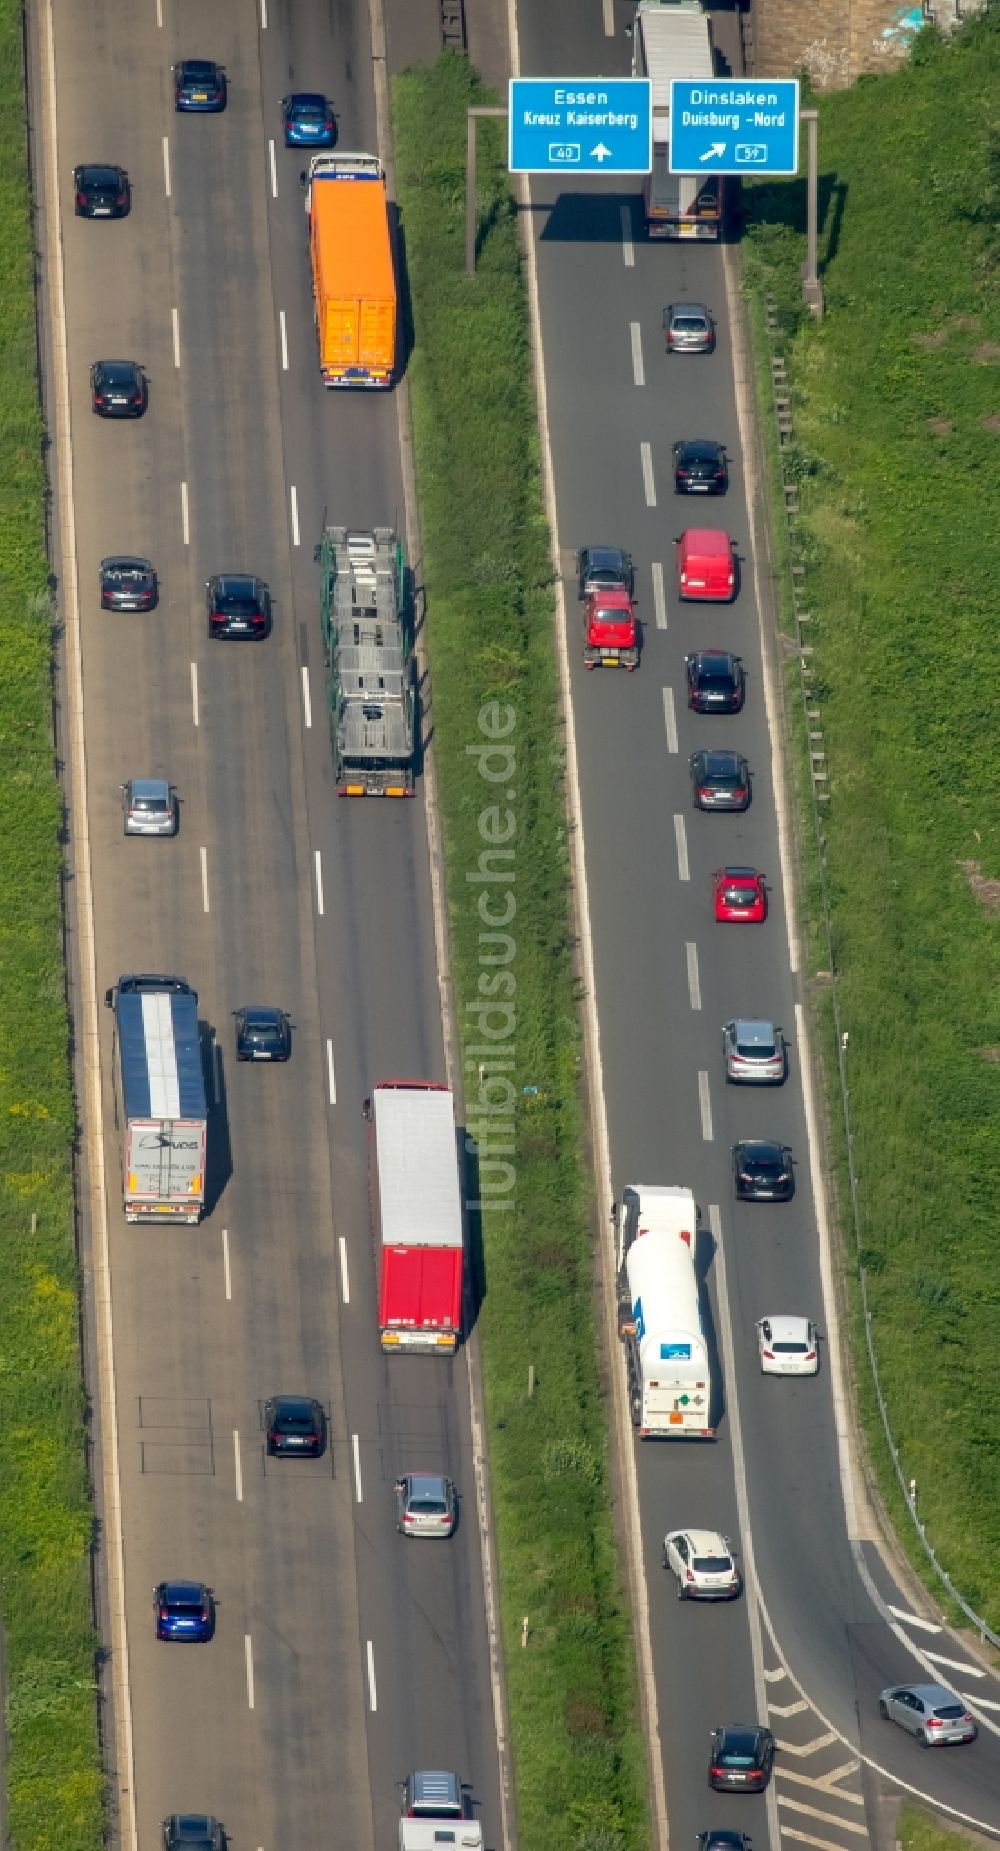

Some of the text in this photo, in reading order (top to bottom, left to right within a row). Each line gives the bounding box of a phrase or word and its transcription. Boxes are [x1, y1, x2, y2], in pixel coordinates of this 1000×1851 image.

[554, 89, 608, 105] Essen
[690, 89, 777, 105] Dinslaken
[524, 111, 638, 130] Kreuz Kaiserberg
[682, 111, 739, 130] Duisburg
[557, 147, 572, 159] 40
